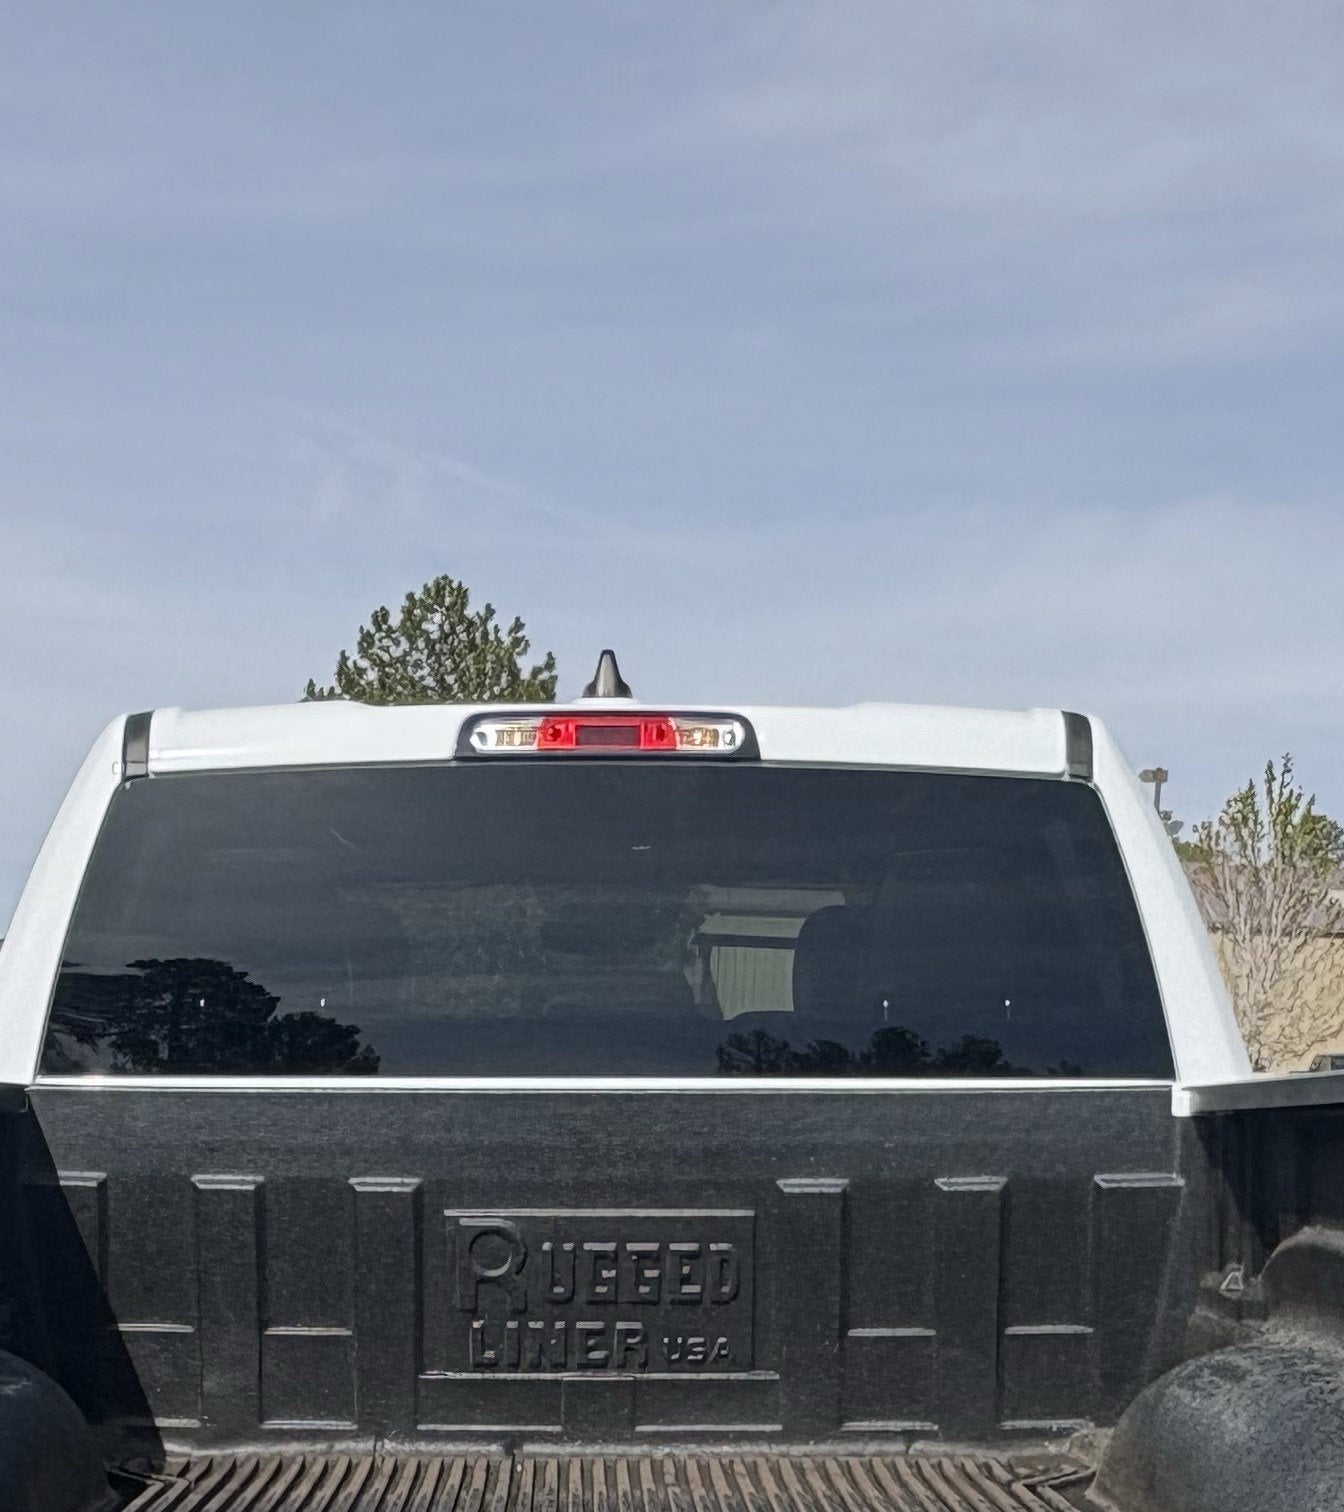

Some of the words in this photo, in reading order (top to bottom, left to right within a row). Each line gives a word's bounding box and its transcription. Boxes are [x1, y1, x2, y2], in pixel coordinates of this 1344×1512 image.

[457, 1217, 739, 1314] RUGGED
[469, 1320, 649, 1369] LINER
[662, 1337, 735, 1362] USA
